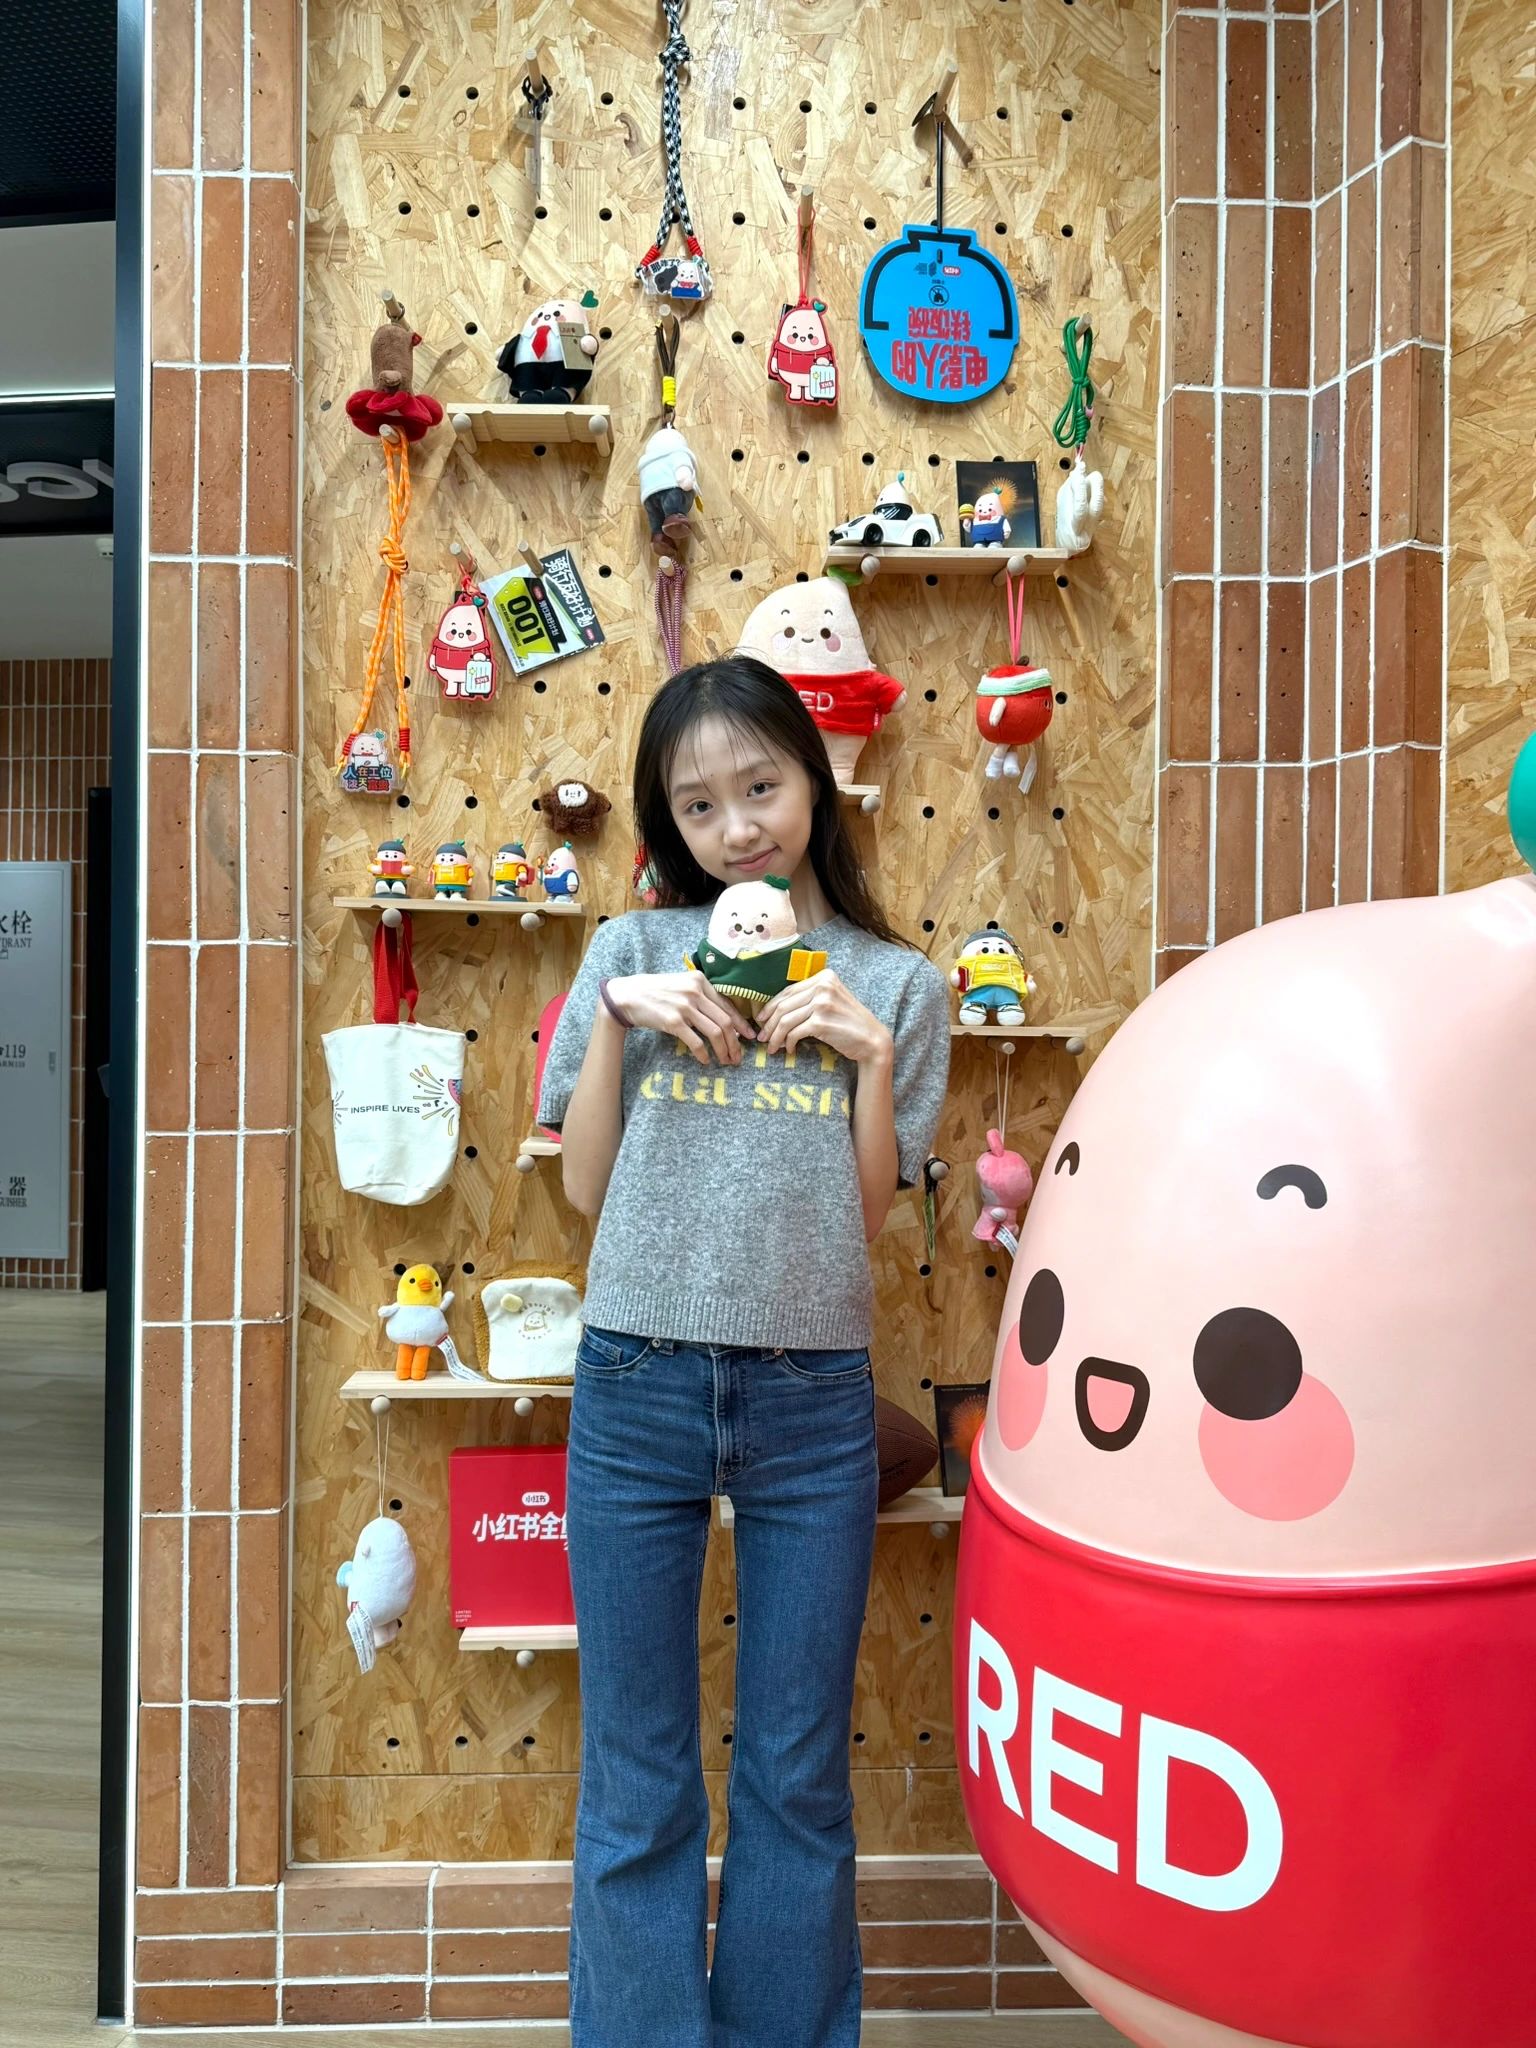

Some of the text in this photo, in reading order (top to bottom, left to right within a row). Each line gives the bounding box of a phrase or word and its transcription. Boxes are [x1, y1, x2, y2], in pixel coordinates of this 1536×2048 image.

[908, 306, 971, 342] 铁饭碗
[891, 339, 989, 390] 电影人的
[507, 595, 546, 645] 001
[798, 690, 834, 712] ED
[344, 766, 392, 779] 人在工位
[0, 1044, 26, 1059] 119
[350, 1104, 420, 1114] INSPIRE LIVES
[525, 1494, 547, 1503] 小红书
[968, 1617, 1284, 1912] RED
